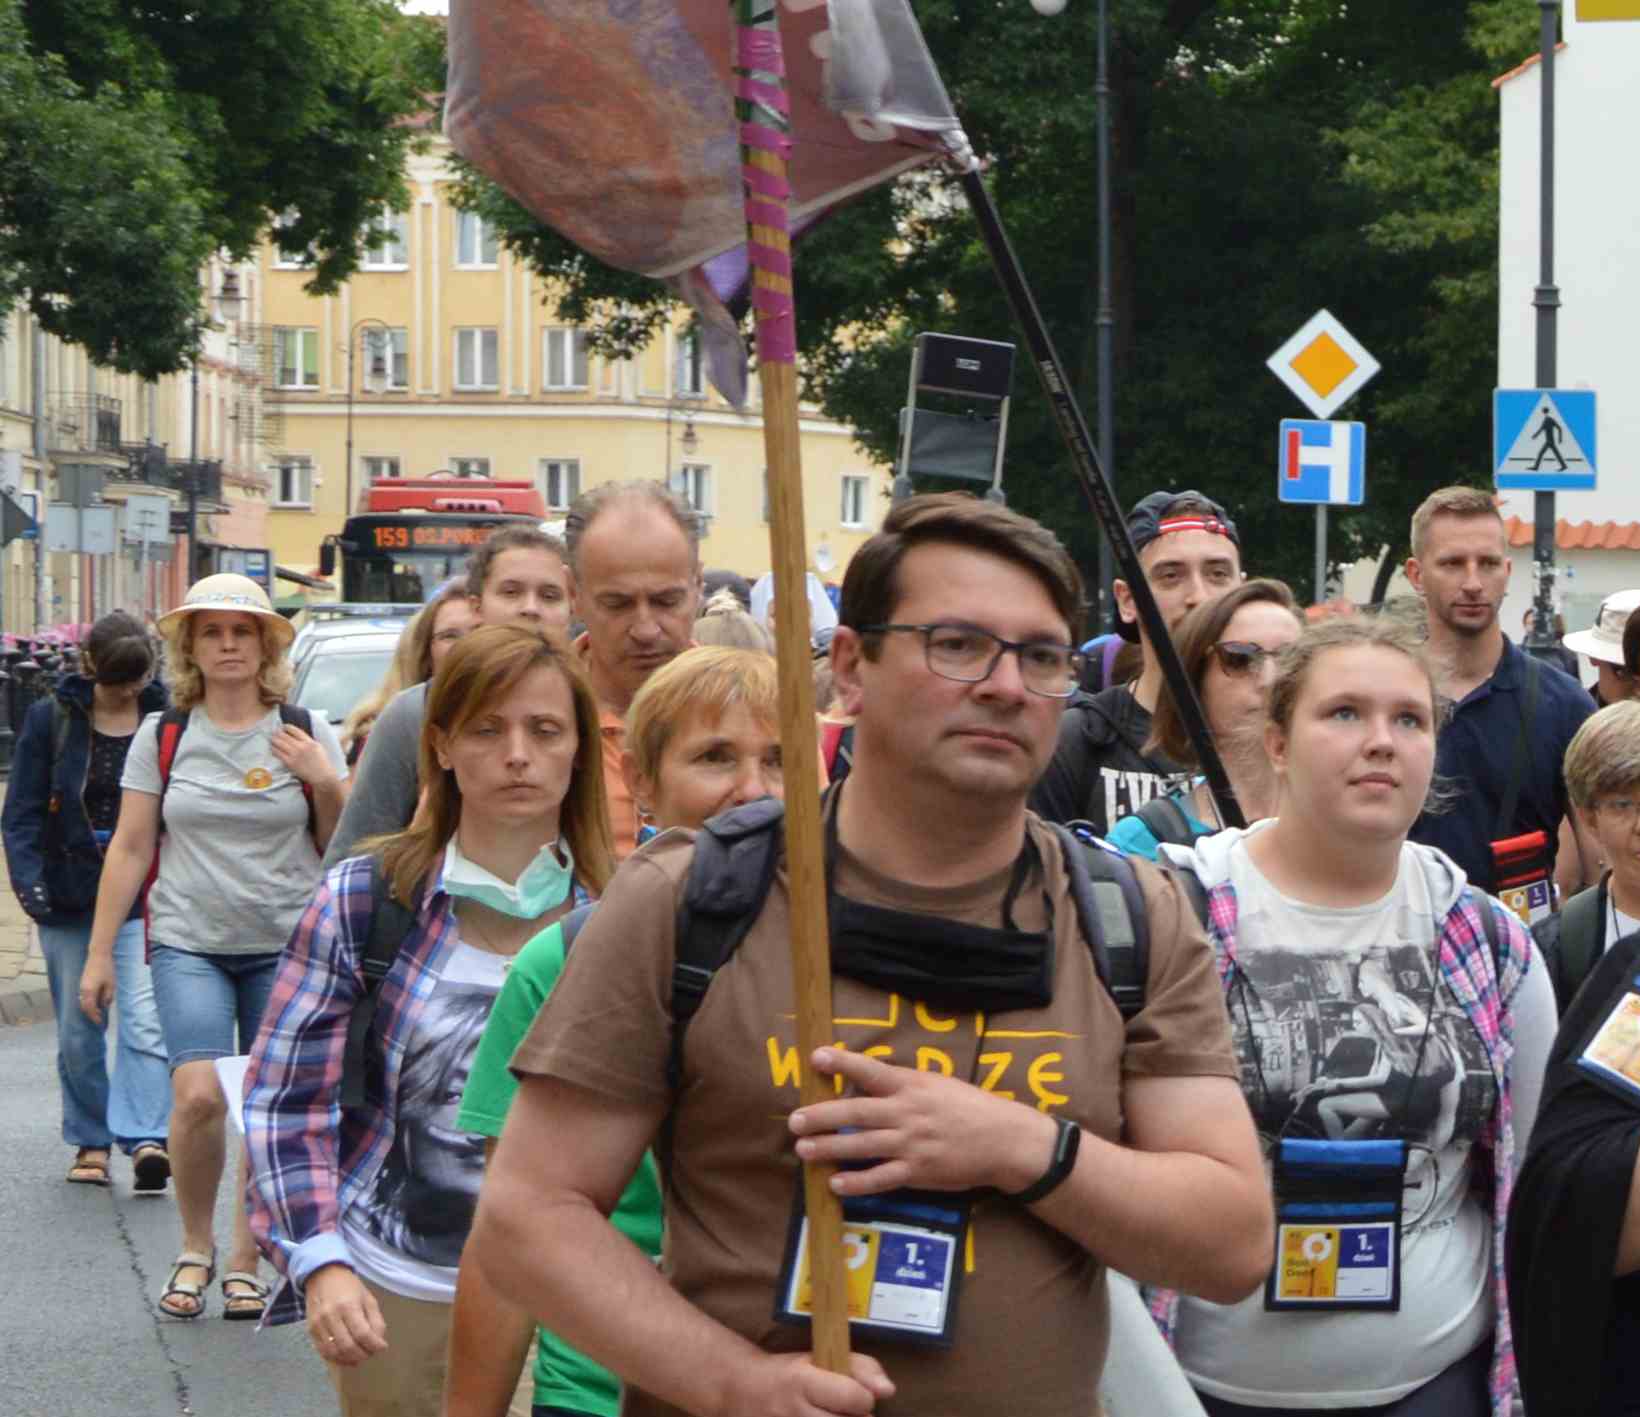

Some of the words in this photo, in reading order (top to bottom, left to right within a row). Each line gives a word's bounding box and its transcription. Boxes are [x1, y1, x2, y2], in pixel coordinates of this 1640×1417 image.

[374, 527, 409, 547] 159
[1357, 1232, 1374, 1252] 1.
[904, 1242, 926, 1266] 1.
